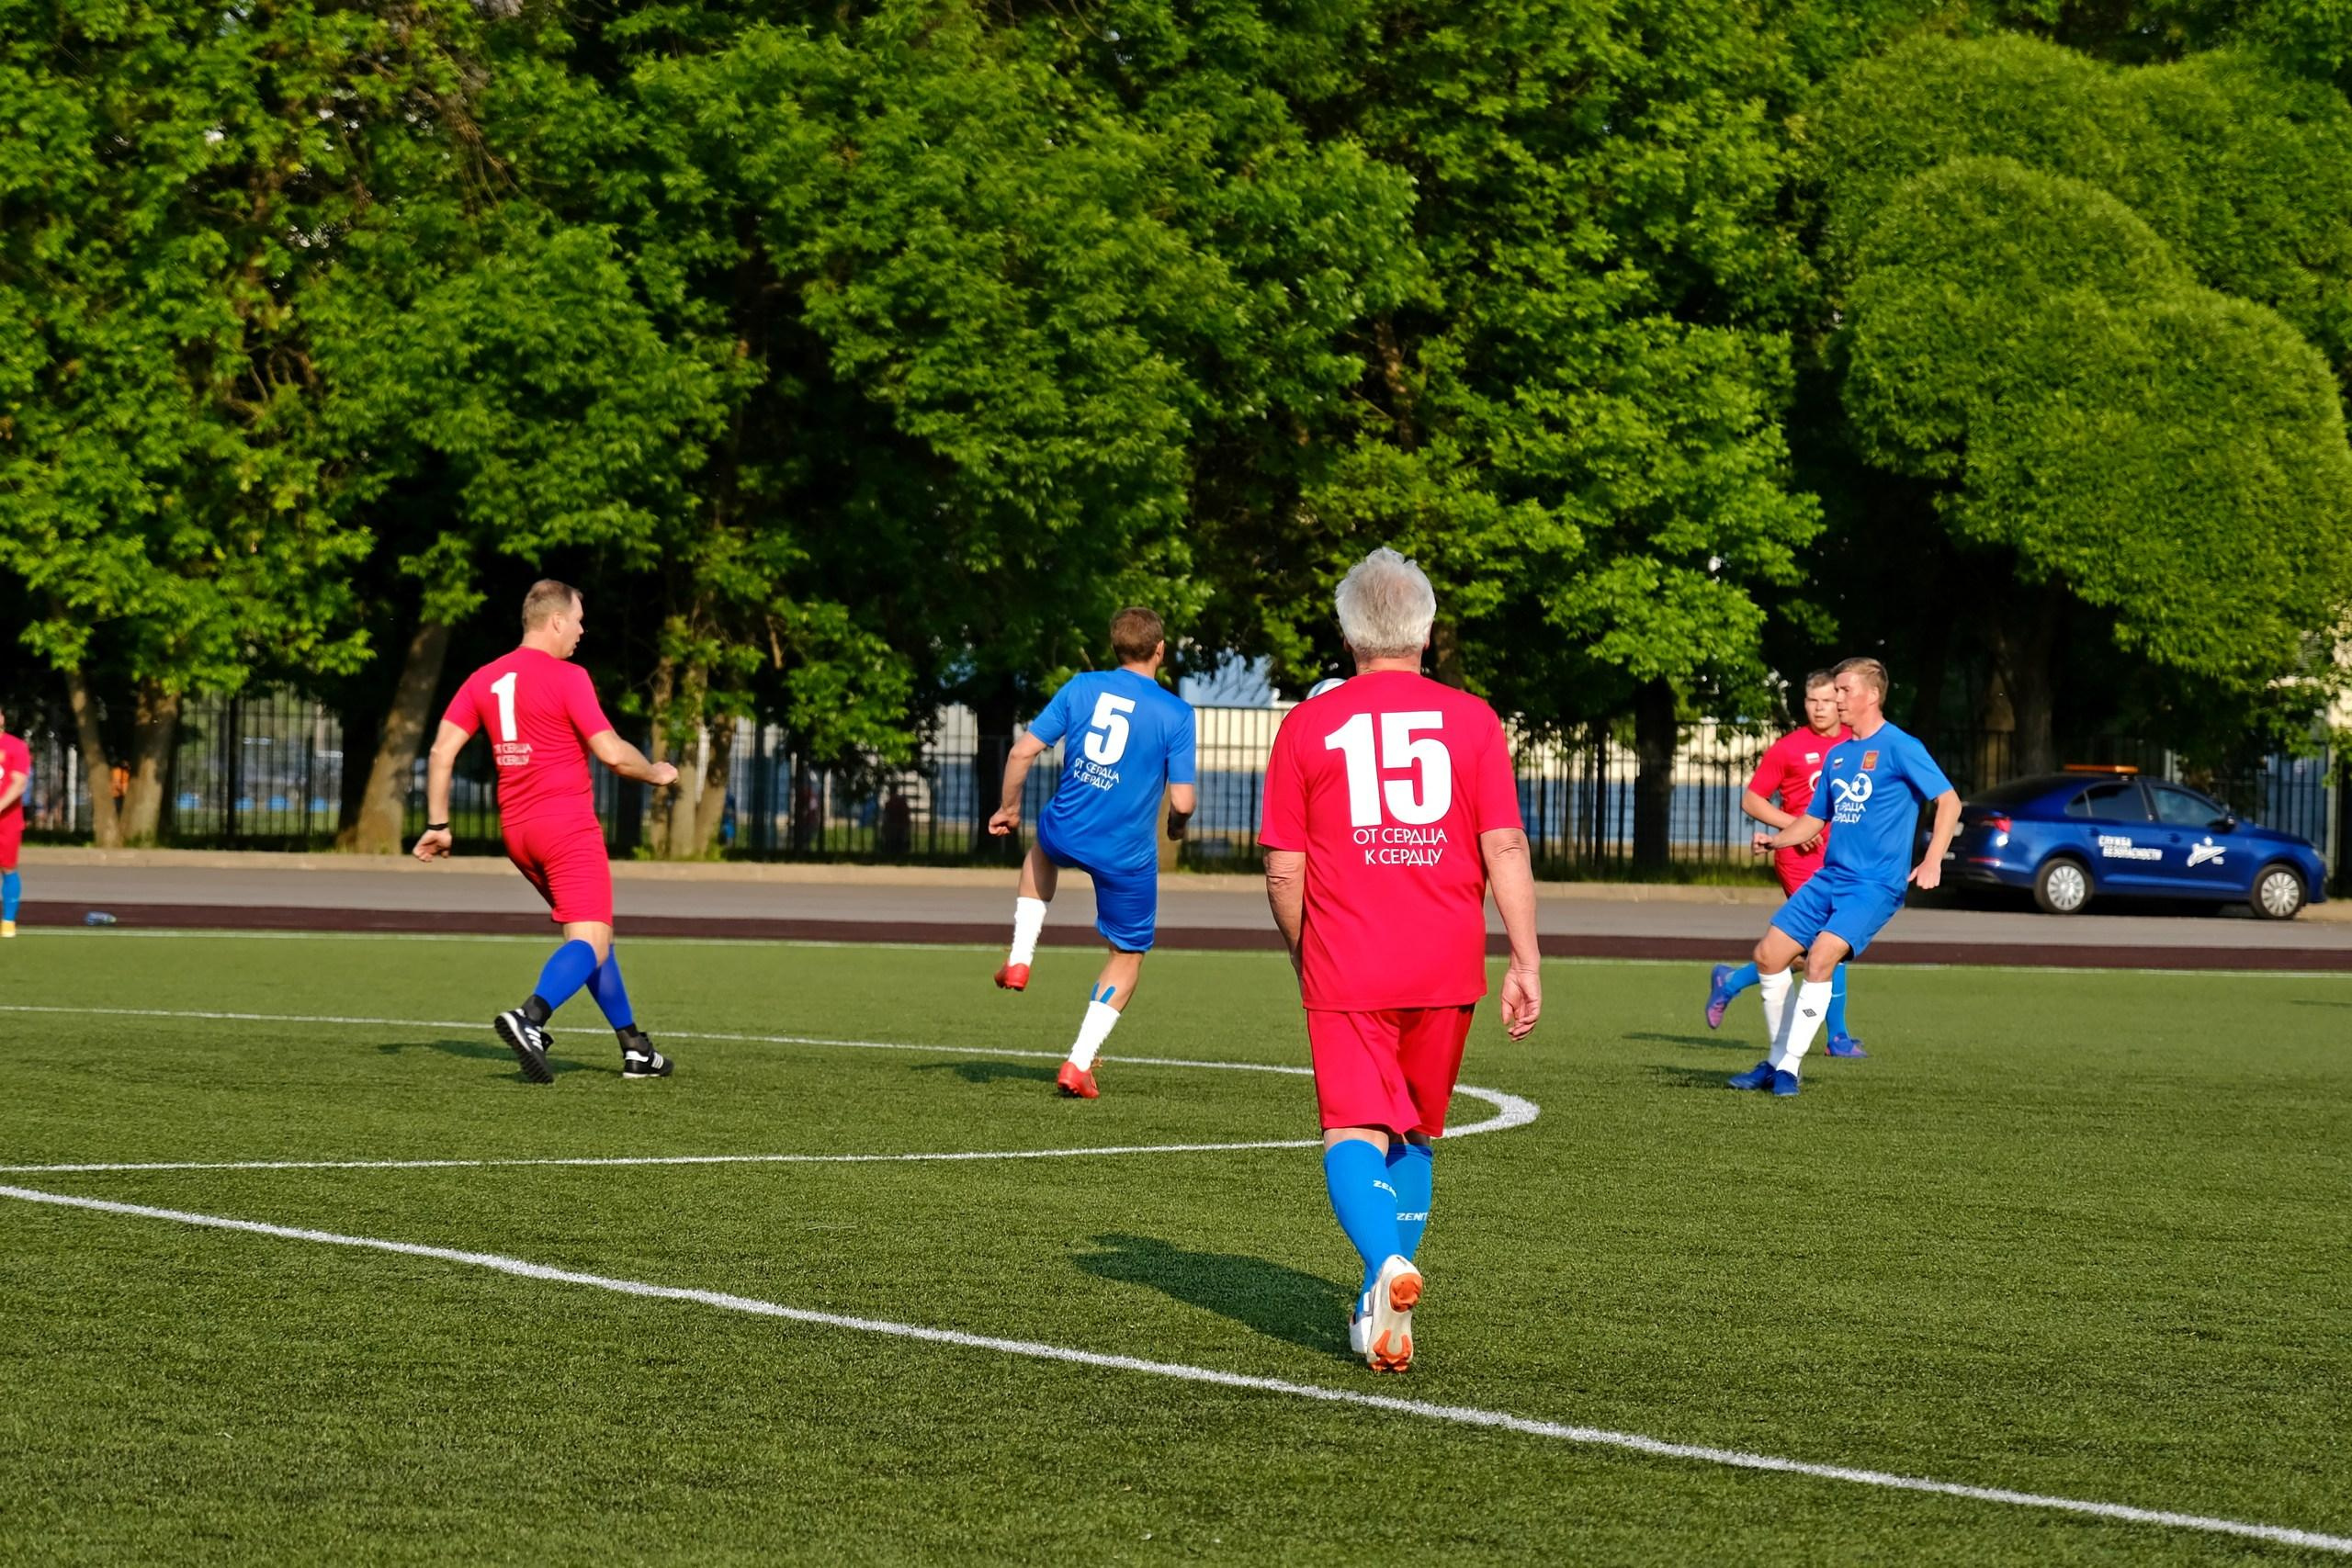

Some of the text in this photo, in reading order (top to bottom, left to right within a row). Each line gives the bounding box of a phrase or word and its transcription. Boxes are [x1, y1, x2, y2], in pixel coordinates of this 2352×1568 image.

[491, 671, 518, 742] 1
[1083, 691, 1136, 766] 5
[1073, 770, 1080, 779] К
[1086, 761, 1119, 784] СЕРДЦА
[1324, 710, 1453, 828] 15
[1352, 828, 1448, 846] ОТ СЕРДЦА
[1364, 848, 1443, 866] К СЕРДЦУ
